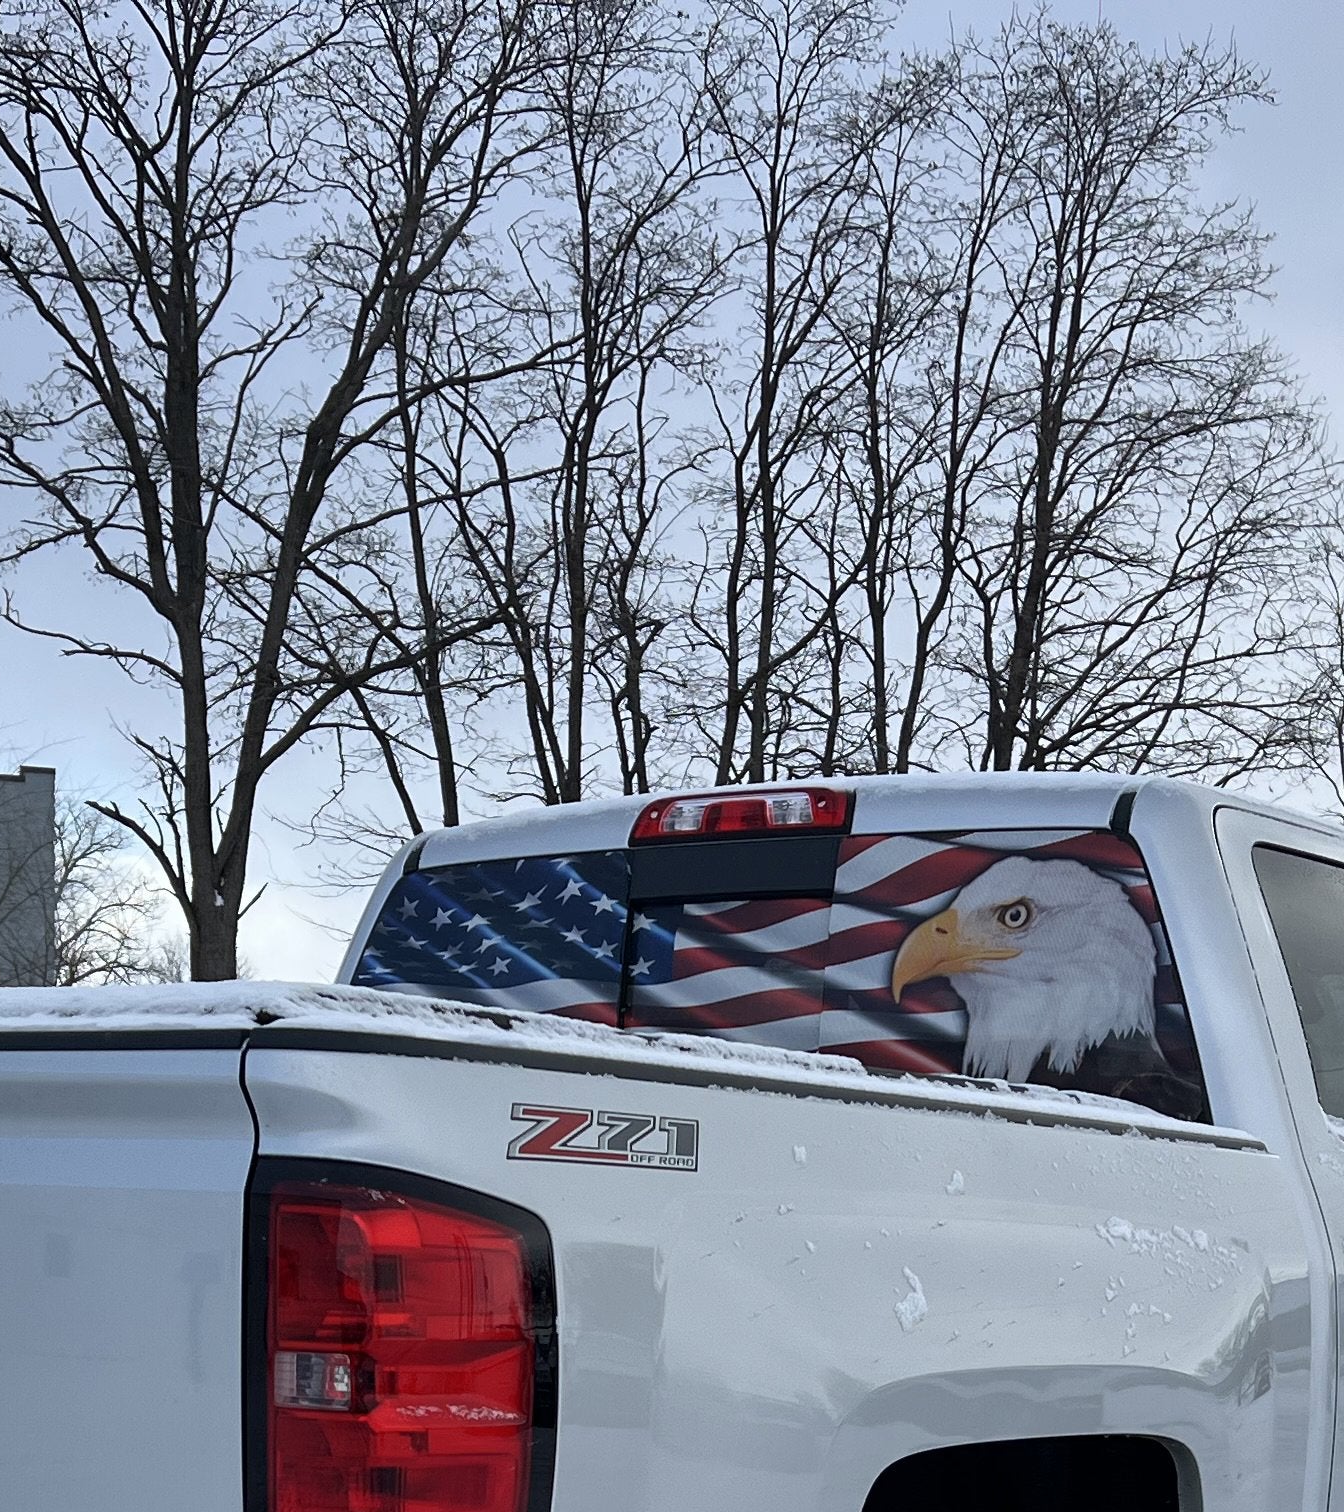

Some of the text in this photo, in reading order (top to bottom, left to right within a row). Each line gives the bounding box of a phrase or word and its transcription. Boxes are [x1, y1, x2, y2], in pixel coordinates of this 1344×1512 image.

[506, 1102, 699, 1172] Z71
[630, 1154, 695, 1168] OFF ROAD
